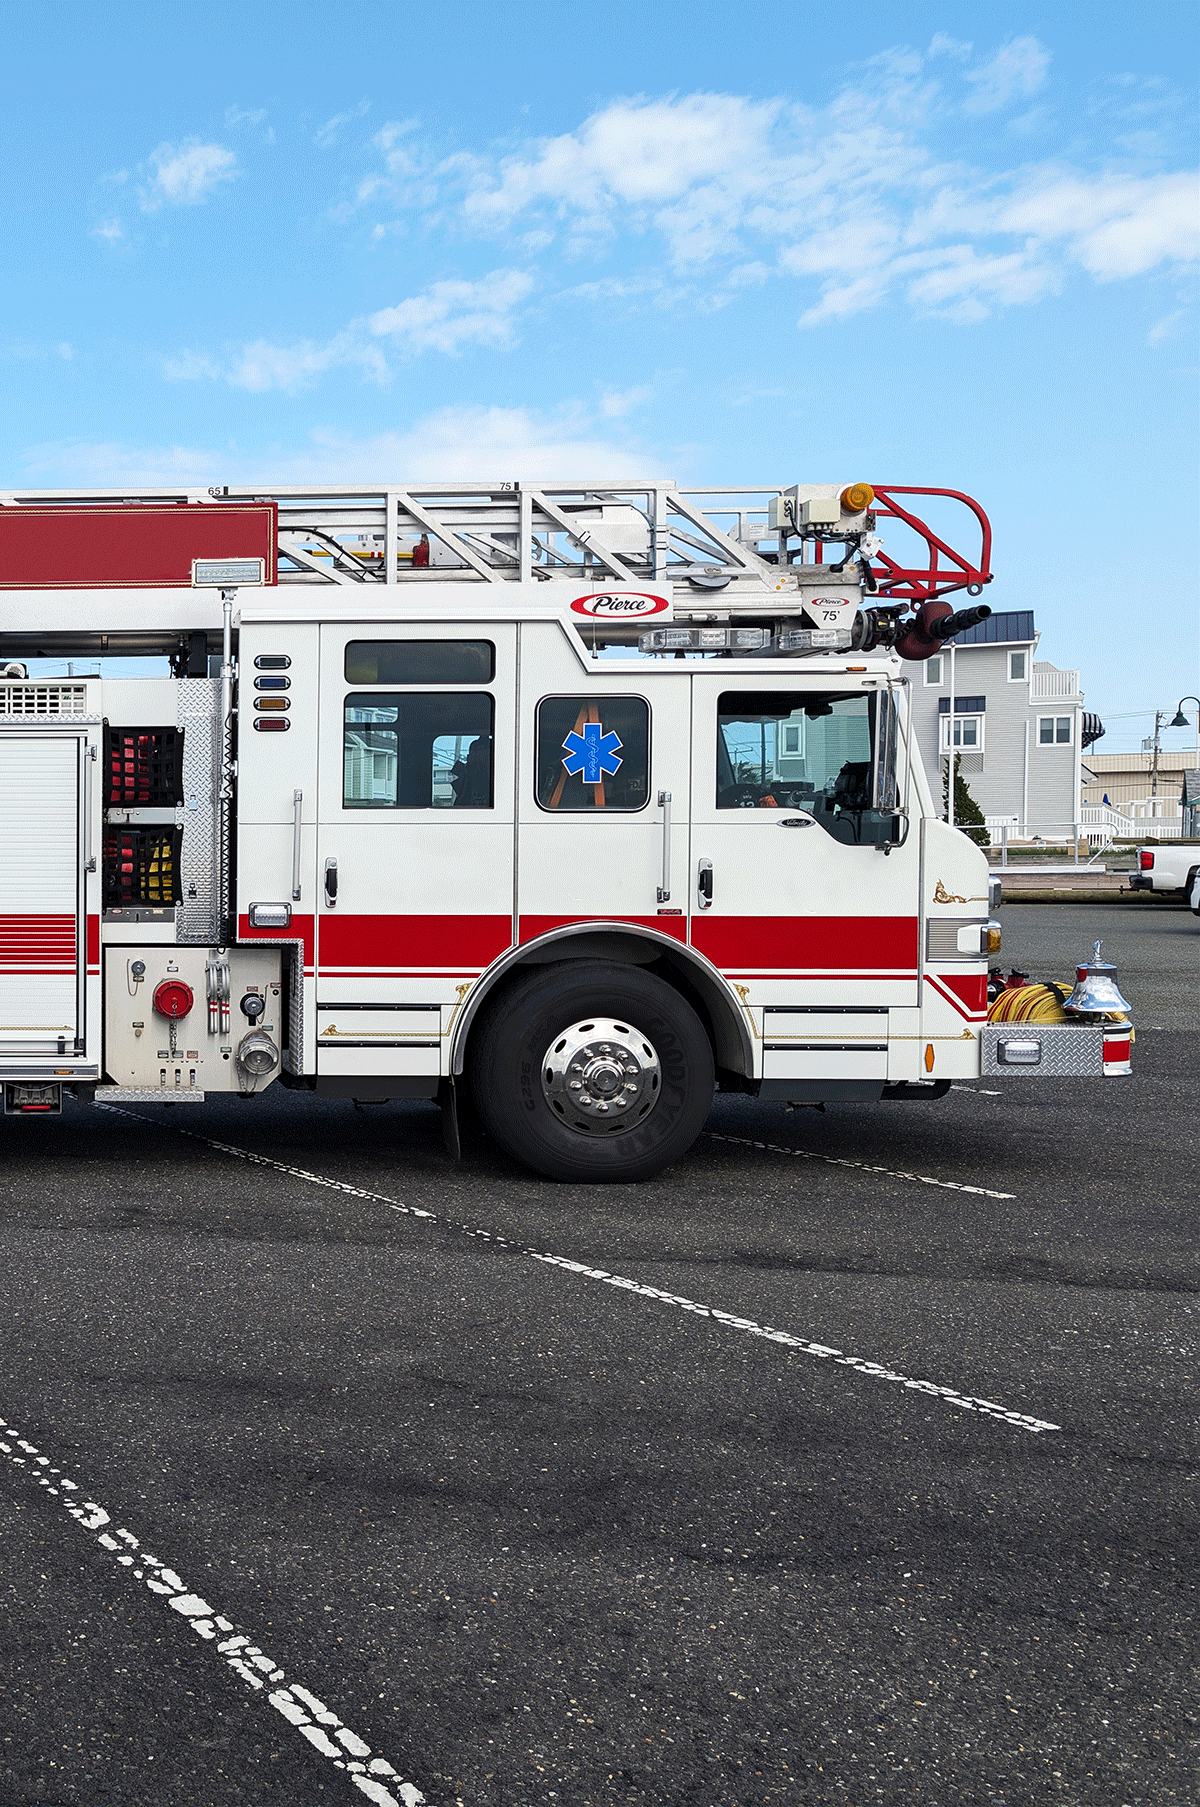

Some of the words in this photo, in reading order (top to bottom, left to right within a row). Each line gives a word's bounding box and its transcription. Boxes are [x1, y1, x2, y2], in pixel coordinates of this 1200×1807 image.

[208, 486, 221, 496] 65
[500, 482, 511, 491] 75
[592, 595, 647, 613] Pierce
[822, 610, 841, 621] 75'
[615, 1017, 686, 1156] GOODYEAR
